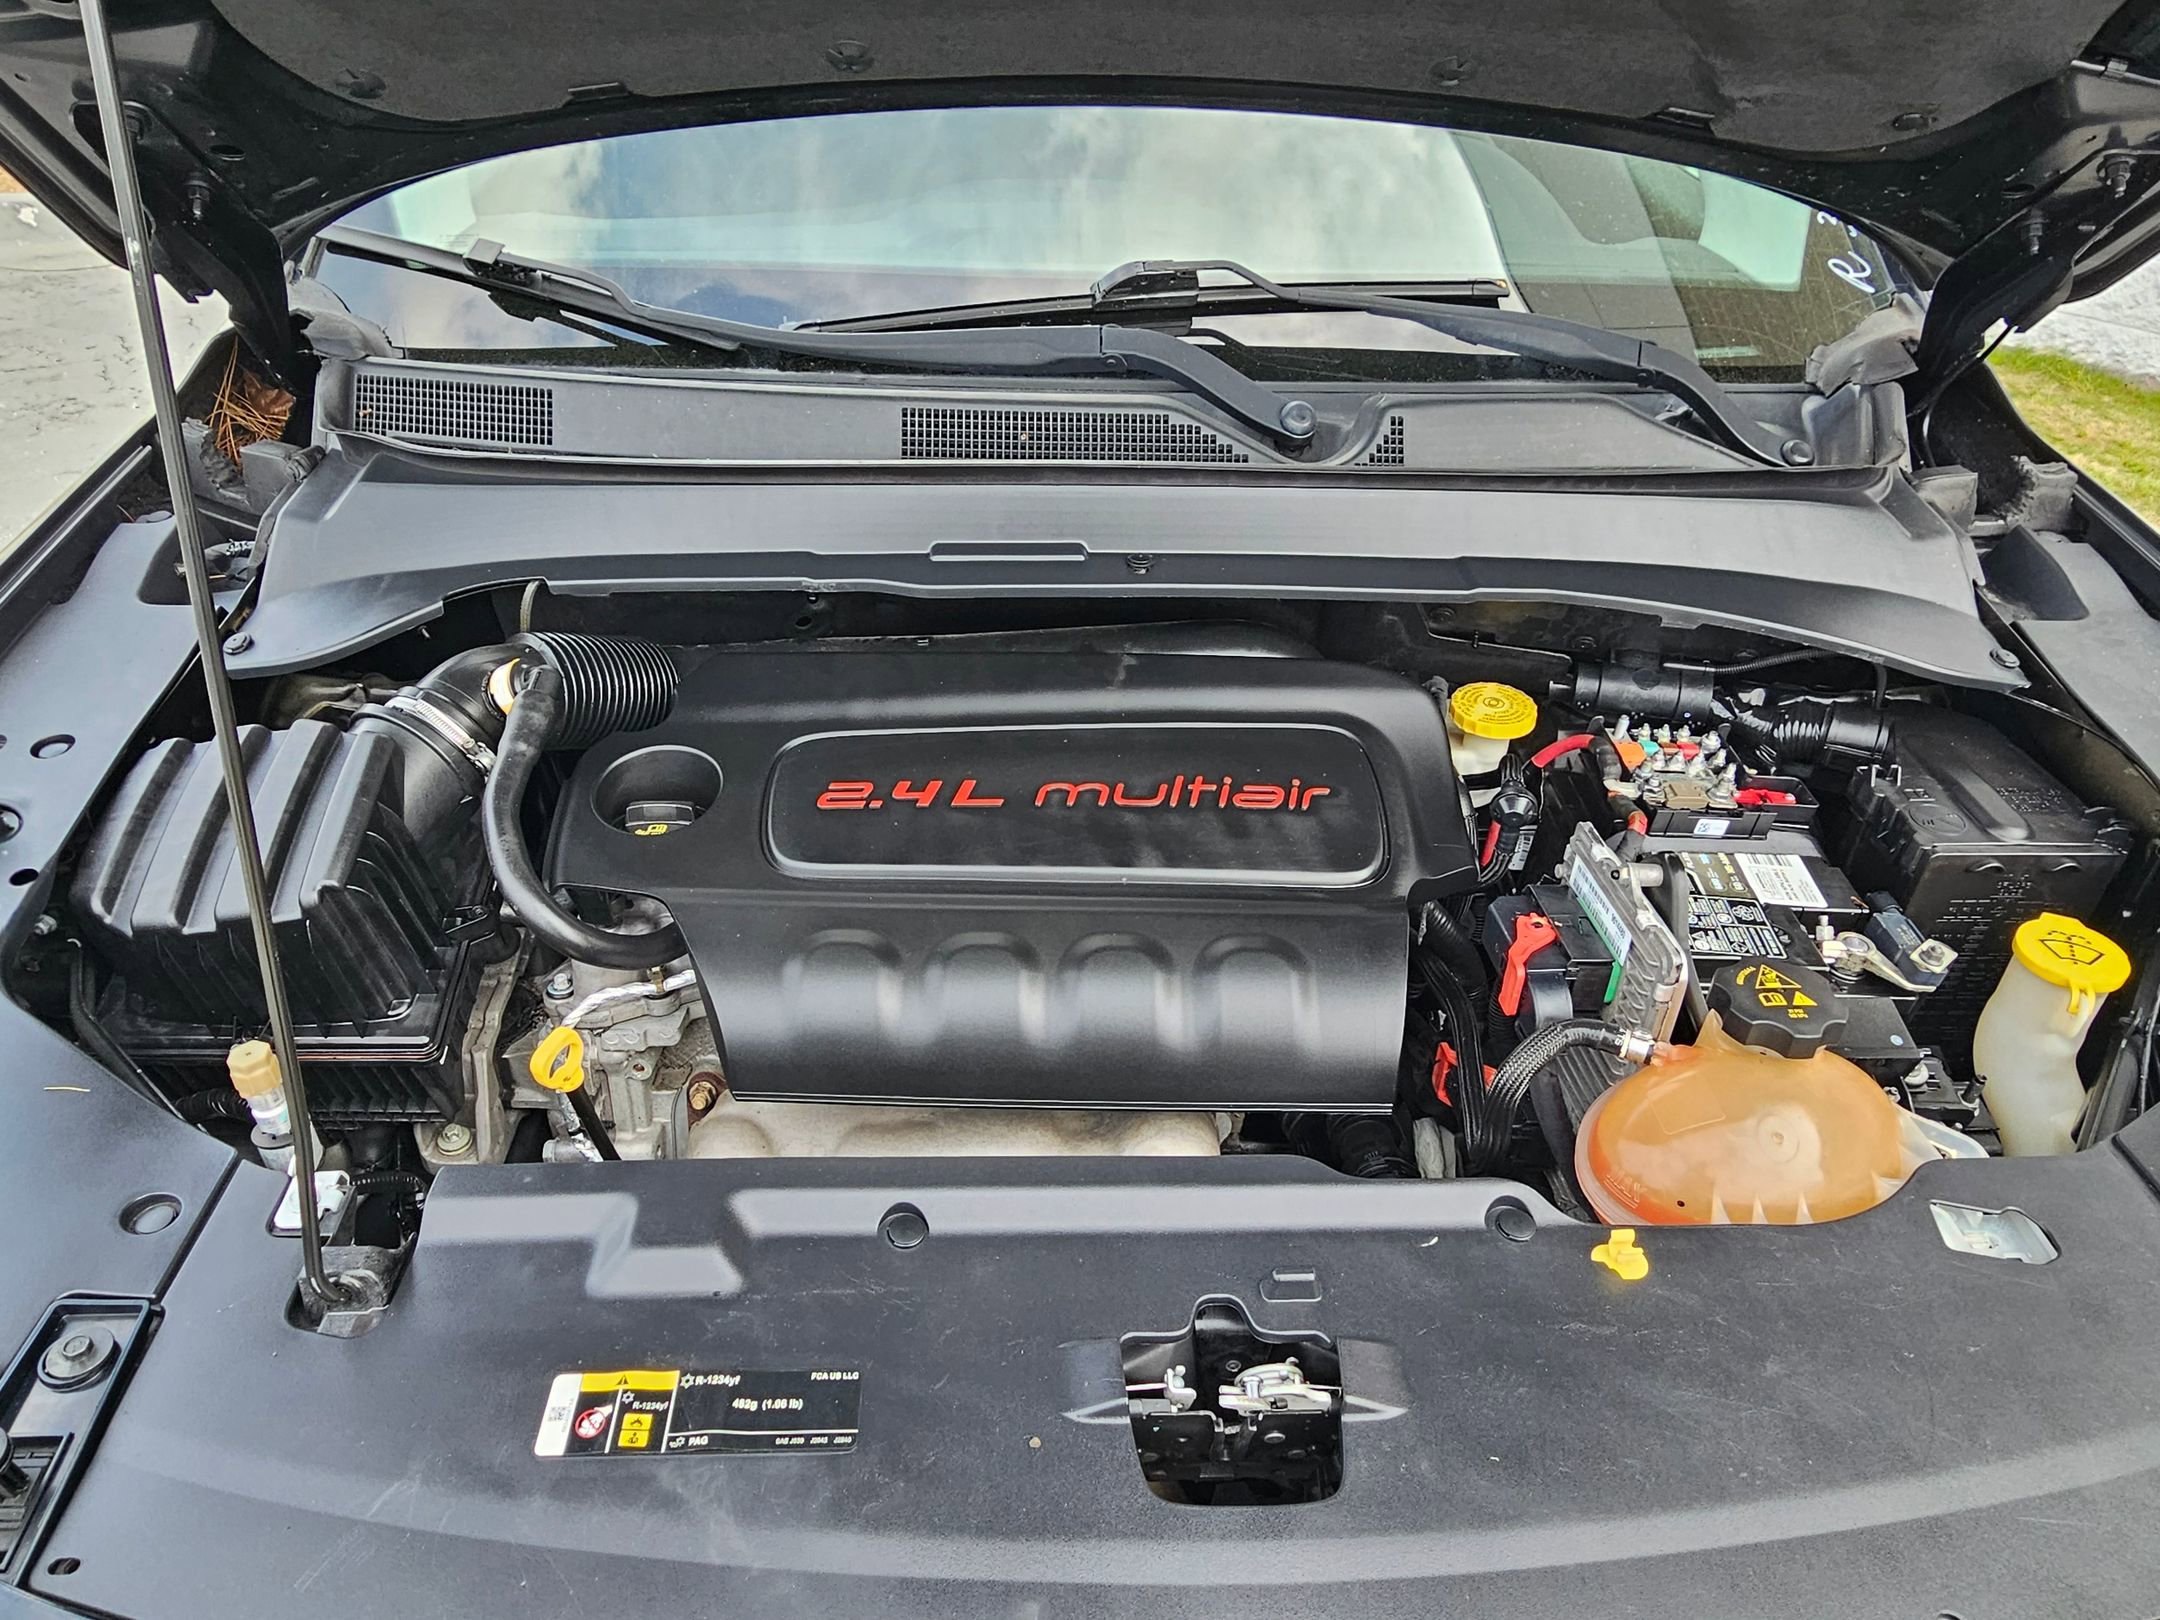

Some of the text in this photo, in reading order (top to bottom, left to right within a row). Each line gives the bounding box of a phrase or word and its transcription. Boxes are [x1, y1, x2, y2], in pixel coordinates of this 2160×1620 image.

[1033, 776, 1330, 811] multiair
[695, 1374, 741, 1387] R-1234yf
[810, 1371, 829, 1381] FCA
[842, 1371, 860, 1380] LLC
[632, 1400, 669, 1412] R-1234yf
[788, 1398, 803, 1411] lb)
[688, 1435, 709, 1447] PAG
